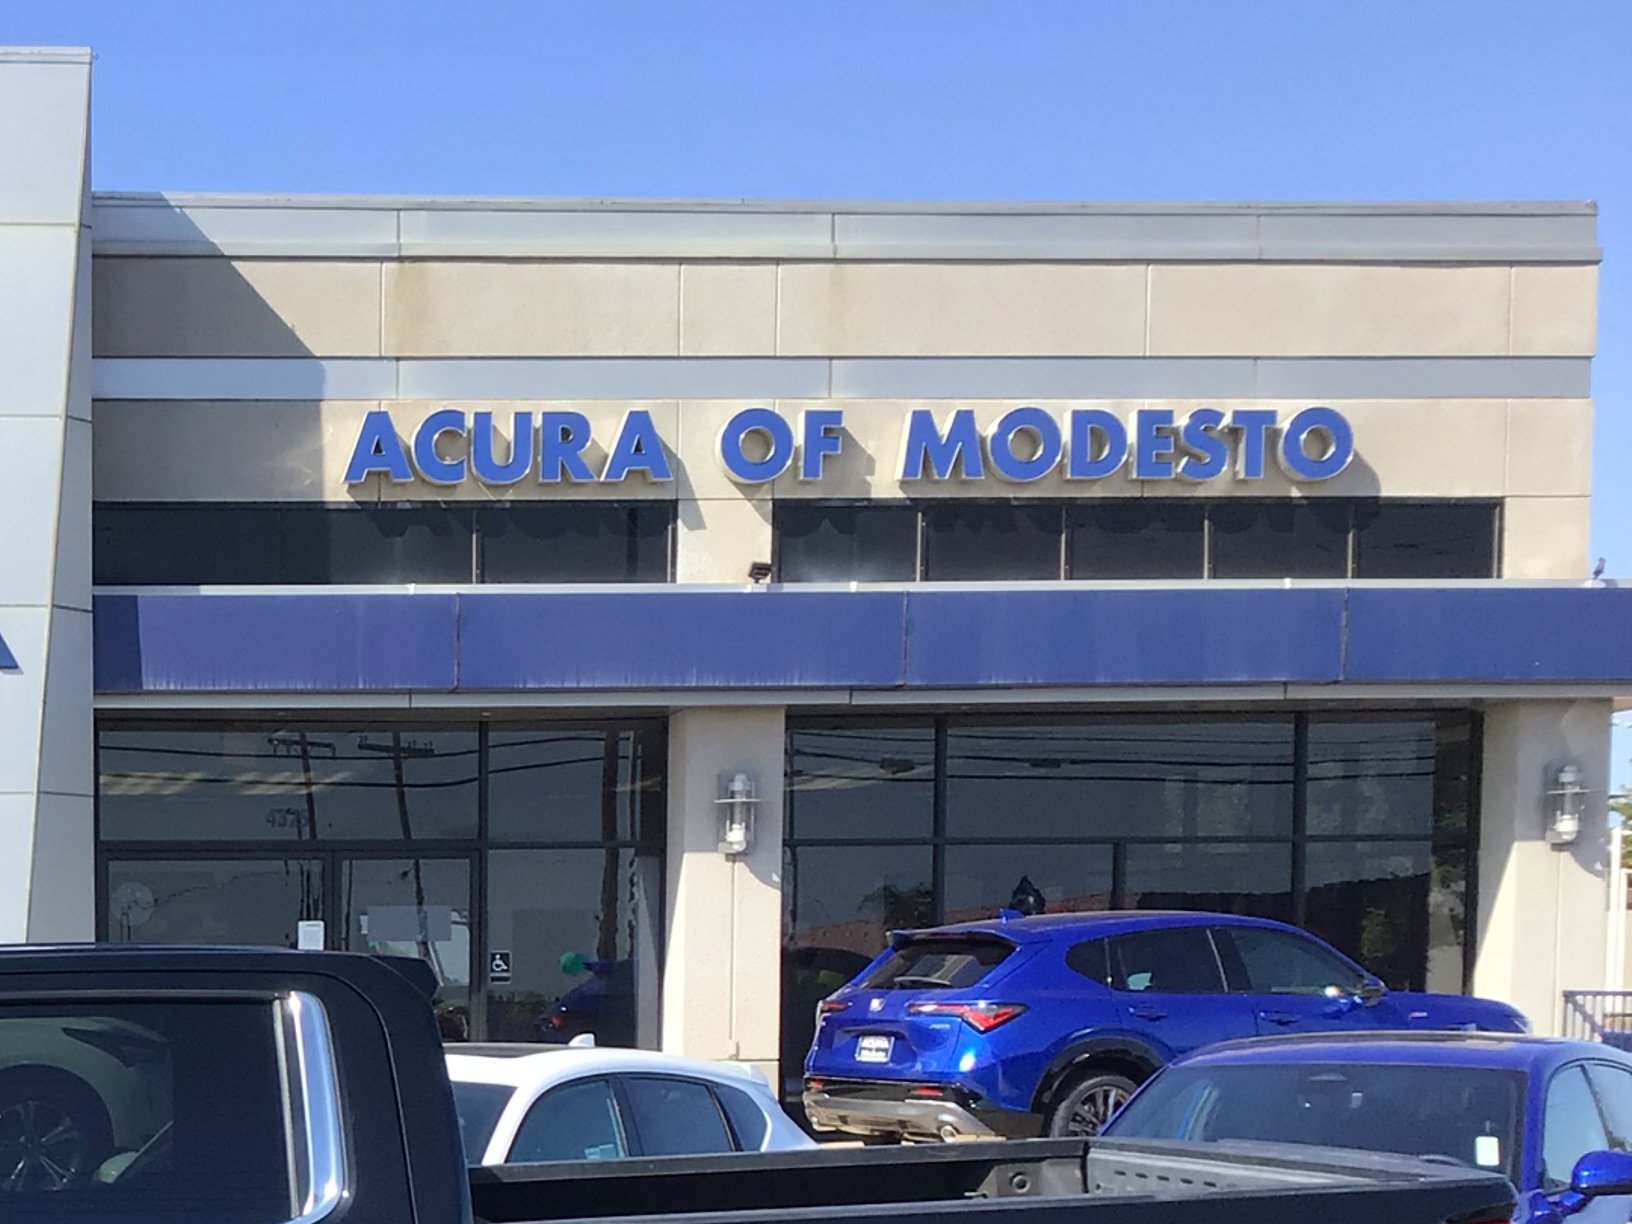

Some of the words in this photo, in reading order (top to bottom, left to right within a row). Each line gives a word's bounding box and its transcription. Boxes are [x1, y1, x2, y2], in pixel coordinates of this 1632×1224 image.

[344, 409, 673, 484] ACURA
[719, 408, 844, 484] OF
[901, 408, 1356, 482] MODESTO
